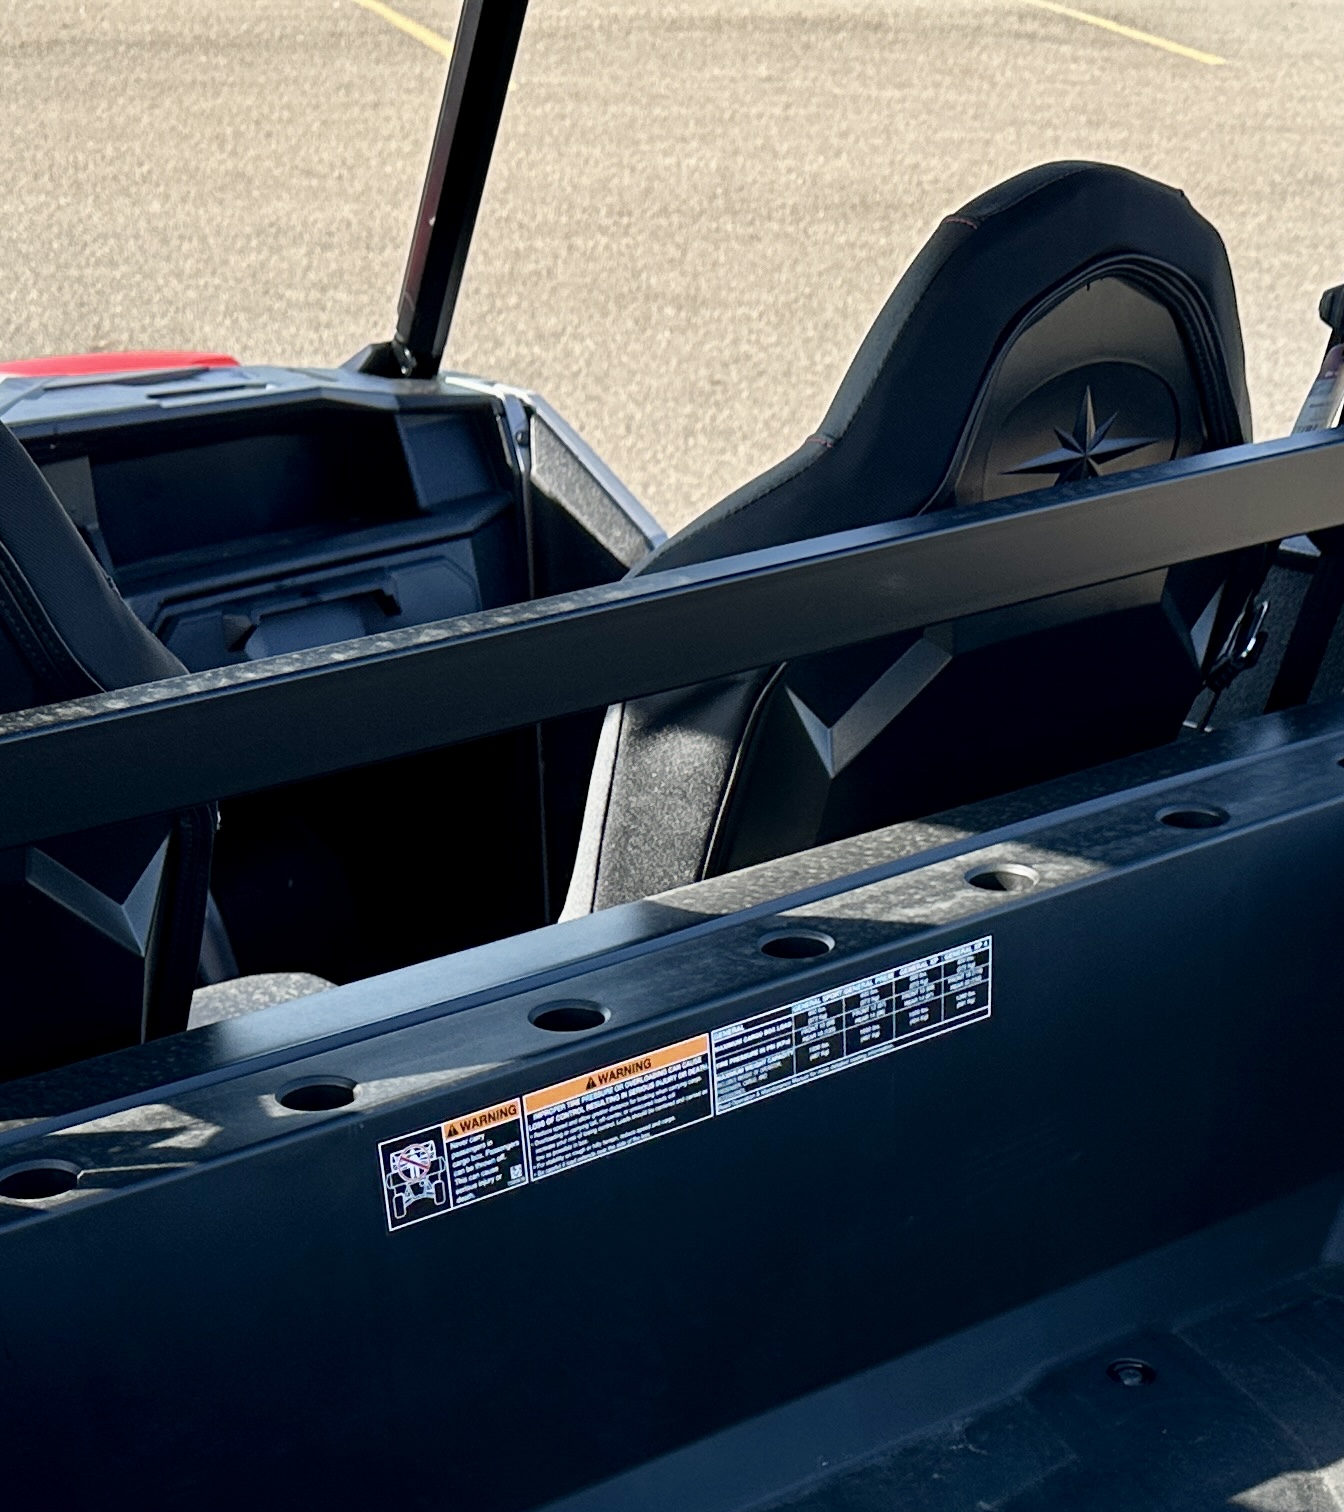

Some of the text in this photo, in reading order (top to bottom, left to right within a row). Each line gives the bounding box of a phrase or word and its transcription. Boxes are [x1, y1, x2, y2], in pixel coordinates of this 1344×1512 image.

[598, 1059, 651, 1084] WARNING
[528, 1120, 545, 1131] LOSS
[546, 1116, 554, 1125] OF
[556, 1106, 585, 1122] CONTROL
[586, 1094, 620, 1111] RESULTING
[628, 1082, 654, 1096] SERIOUS
[655, 1074, 677, 1087] INJURY
[678, 1070, 687, 1079] OR
[533, 1104, 566, 1120] IMPROPER
[567, 1098, 580, 1108] TIRE
[581, 1087, 613, 1103] PRESSURE
[614, 1083, 624, 1092] OR
[460, 1105, 516, 1131] WARNING
[452, 1157, 470, 1168] cargo
[485, 1140, 519, 1156] Passengers
[454, 1166, 499, 1185] This can cause
[466, 1165, 474, 1173] be
